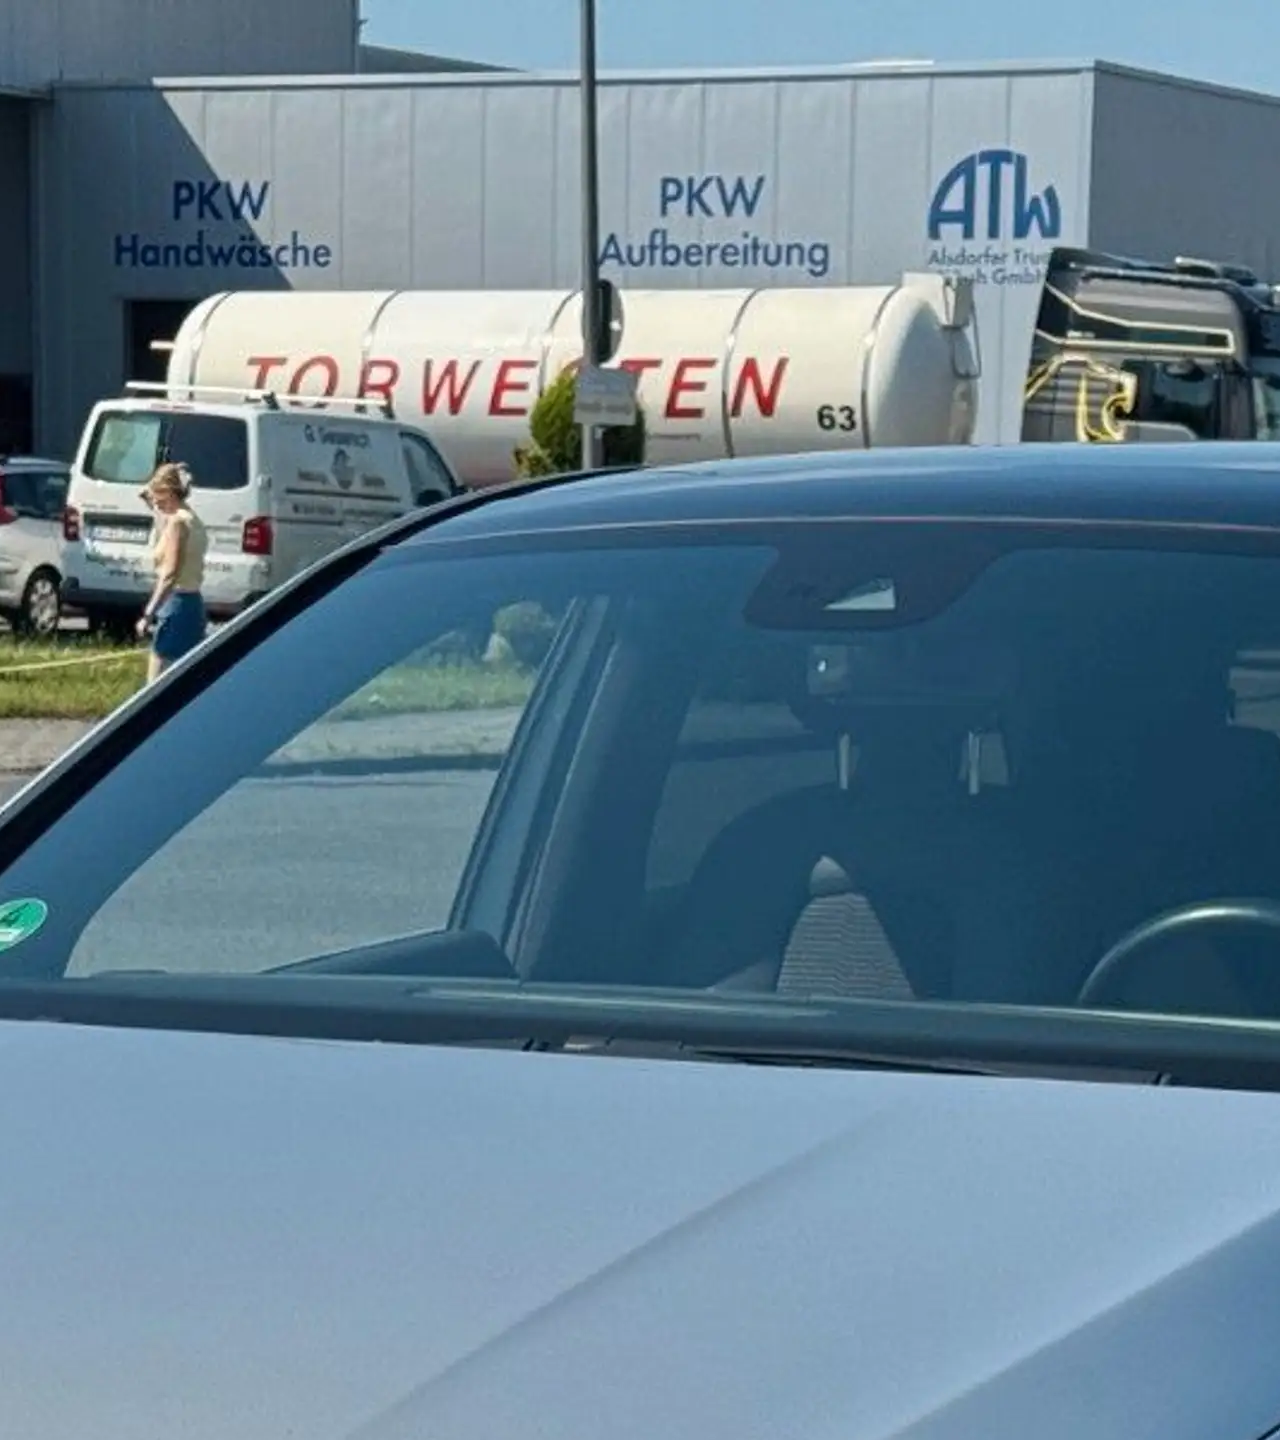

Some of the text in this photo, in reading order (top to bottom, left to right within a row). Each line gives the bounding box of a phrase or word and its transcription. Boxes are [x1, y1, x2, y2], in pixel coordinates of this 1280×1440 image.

[172, 179, 269, 221] PKW
[660, 175, 765, 218] PKW
[928, 149, 1061, 239] ATW
[114, 230, 332, 268] Handwäsche
[597, 228, 830, 277] Aufbereitung
[246, 355, 790, 420] TORWETEN
[818, 404, 856, 431] 63
